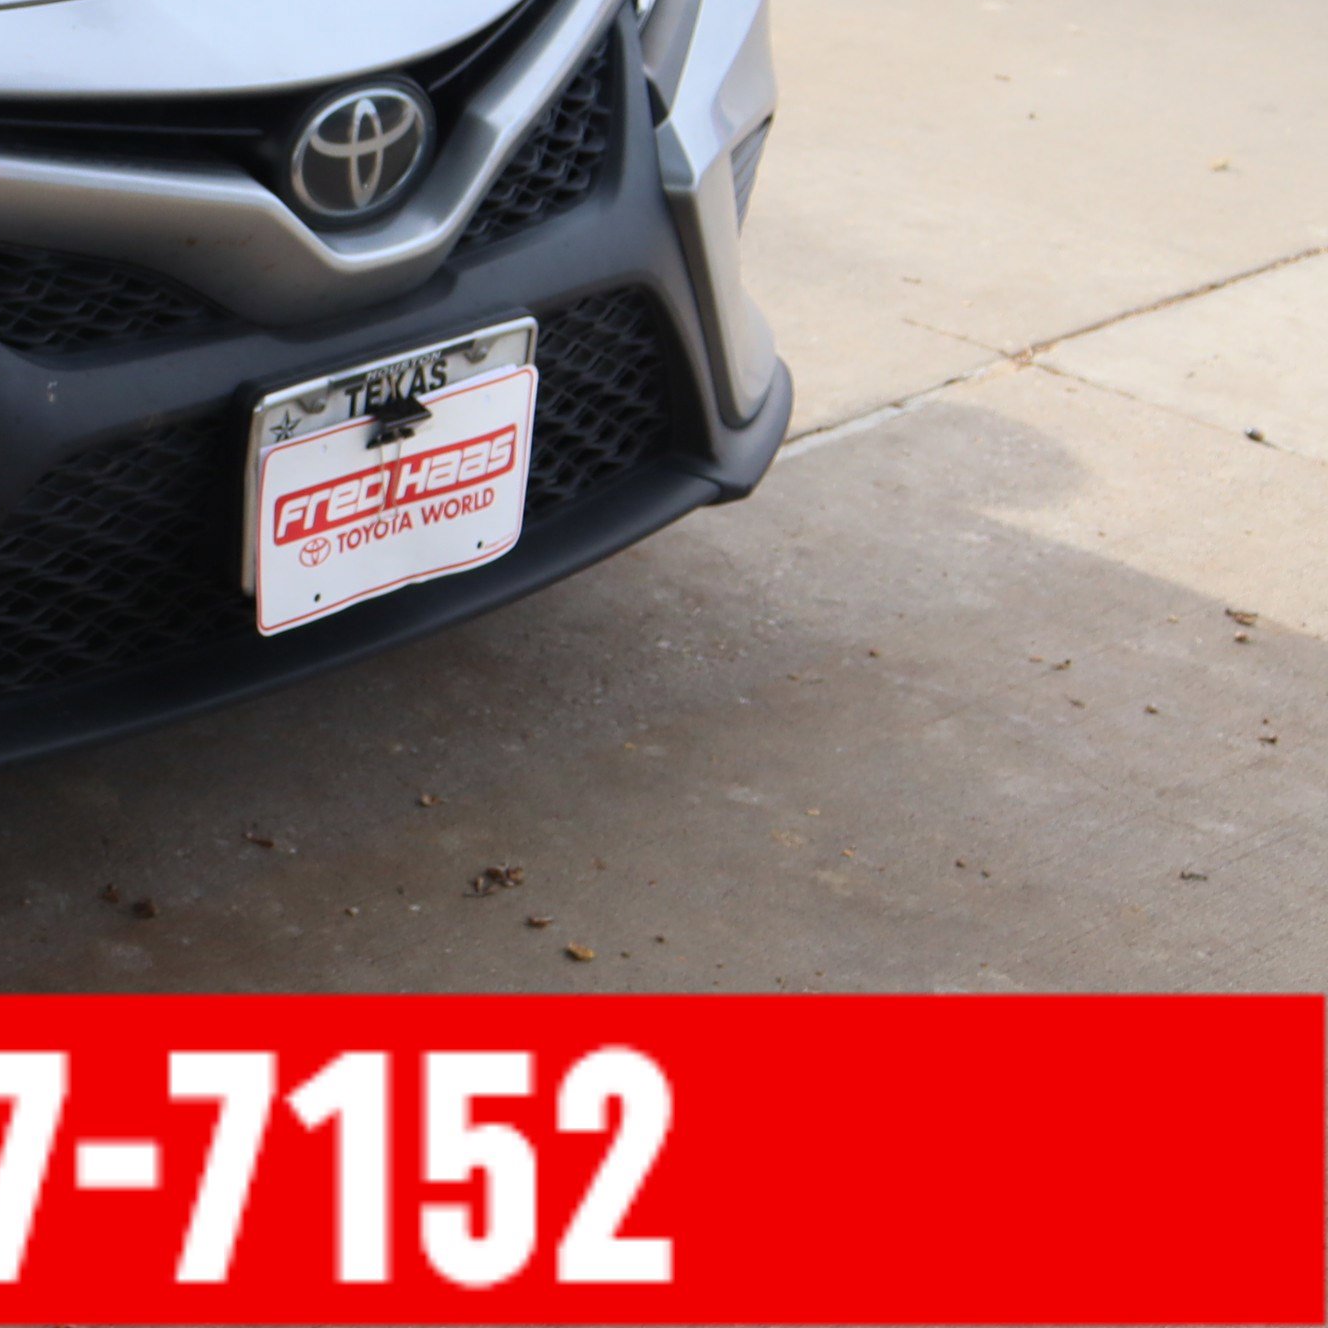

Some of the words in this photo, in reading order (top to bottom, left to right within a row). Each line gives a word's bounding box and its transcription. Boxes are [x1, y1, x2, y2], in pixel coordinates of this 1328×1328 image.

[345, 360, 447, 418] TEXAS
[337, 511, 413, 554] TOYOTA
[421, 487, 495, 526] WORLD
